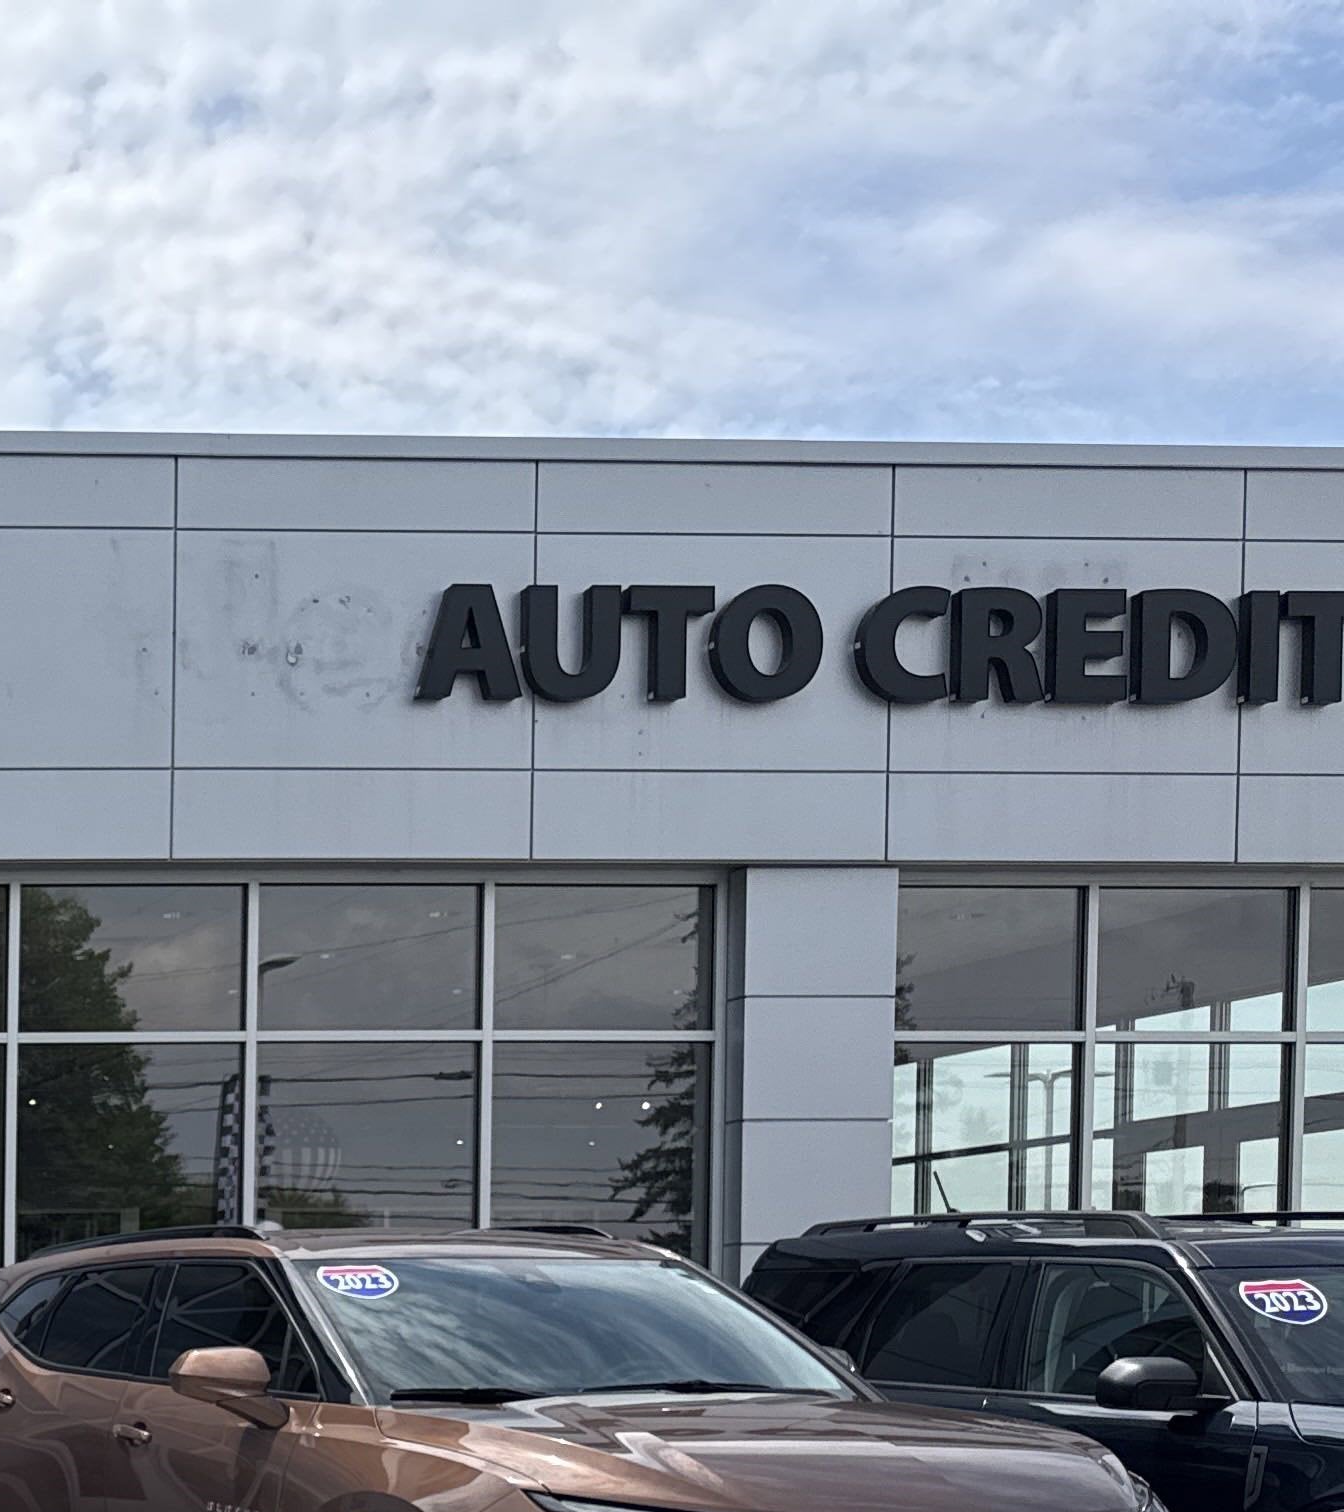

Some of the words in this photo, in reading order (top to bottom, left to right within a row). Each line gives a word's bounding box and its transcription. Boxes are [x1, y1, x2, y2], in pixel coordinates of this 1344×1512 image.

[413, 583, 824, 704] AUTO
[851, 586, 1344, 706] CREDIT
[329, 1273, 393, 1290] 2023
[1253, 1290, 1321, 1312] 2023
